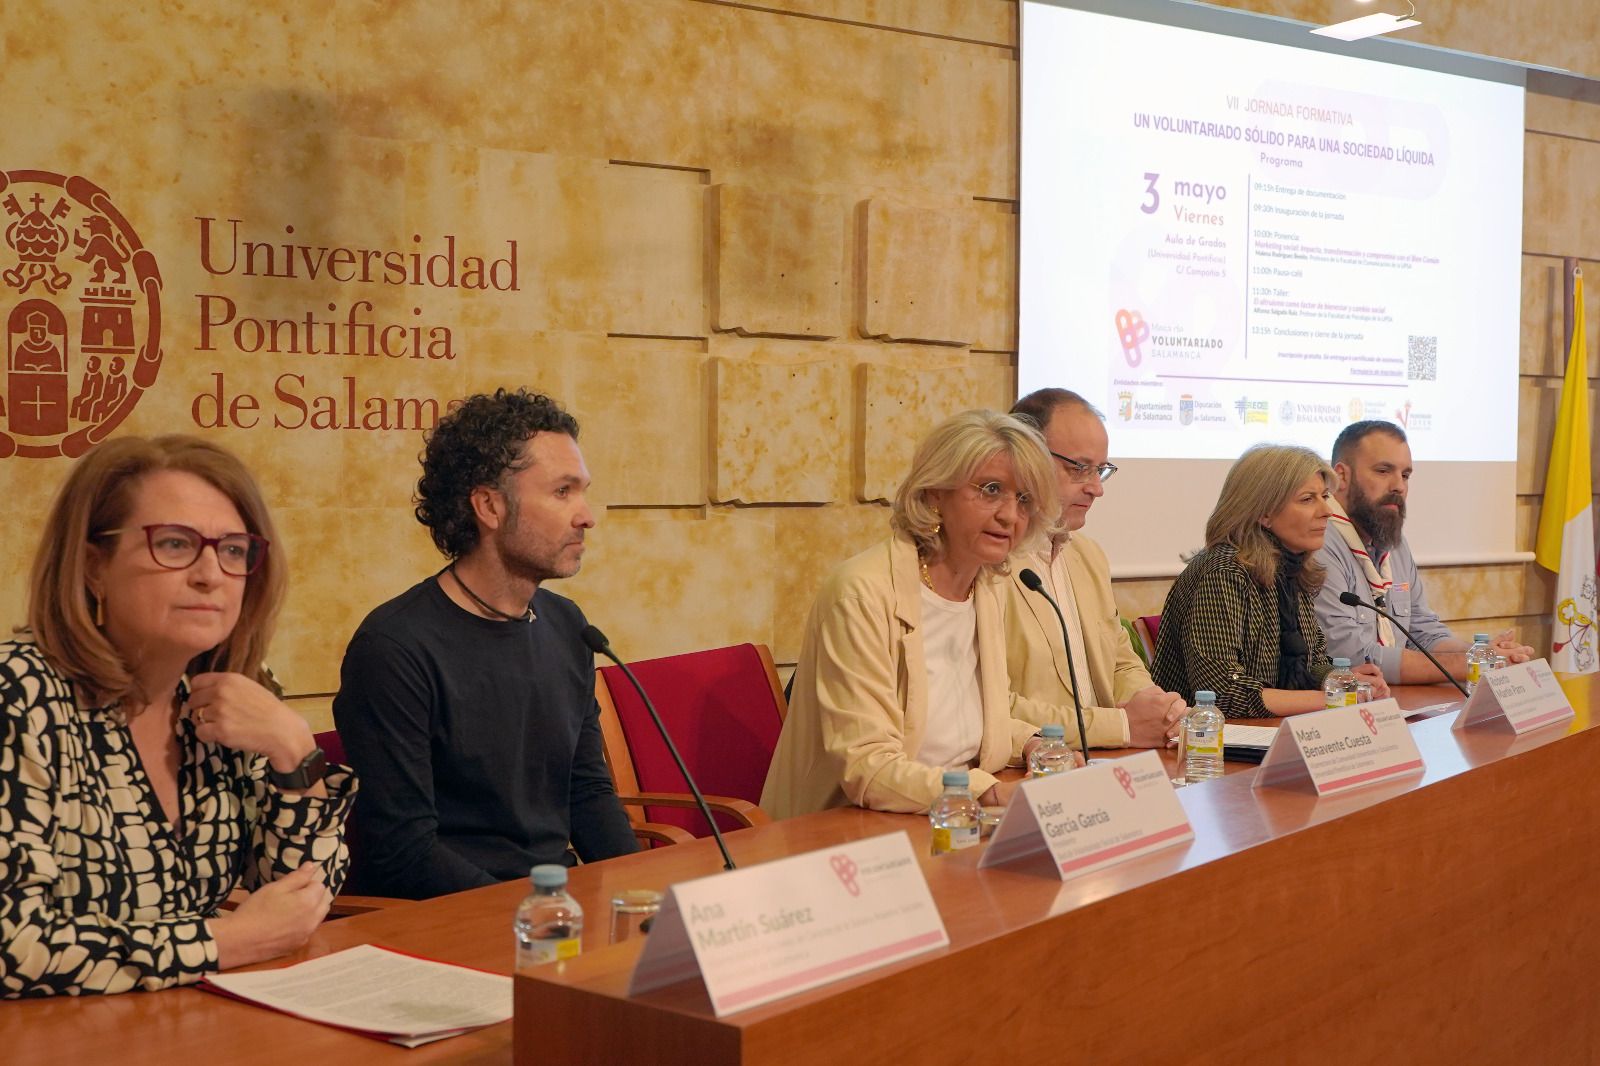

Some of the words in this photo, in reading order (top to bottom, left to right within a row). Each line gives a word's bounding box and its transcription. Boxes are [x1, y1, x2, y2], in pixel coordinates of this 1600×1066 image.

[1226, 95, 1239, 110] VII
[1244, 98, 1295, 118] JORNADA
[1296, 105, 1353, 126] FORMATIVA
[1133, 112, 1150, 129] UN
[1153, 115, 1242, 141] VOLUNTARIADO
[1244, 124, 1285, 147] SÓLIDO
[1287, 133, 1316, 151] PARA
[1319, 138, 1340, 154] UNA
[1343, 141, 1394, 161] SOCIEDAD
[1396, 146, 1435, 166] LÍQUIDA
[1260, 152, 1303, 168] Programa
[1140, 172, 1160, 214] 3
[1174, 181, 1226, 205] mayo
[1174, 204, 1224, 226] Viernes
[1165, 232, 1183, 245] Aula
[1186, 234, 1196, 245] de
[1198, 236, 1226, 248] Grados
[194, 216, 521, 292] Universidad
[193, 294, 457, 360] Pontificia
[1151, 335, 1224, 349] VOLUNTARIADO
[1151, 349, 1201, 360] SALAMANCA
[191, 372, 260, 429] de
[274, 372, 464, 431] Salam
[1134, 401, 1173, 411] Ayuntamiento
[1134, 412, 1142, 420] de
[1142, 412, 1173, 421] Salamanca
[1295, 727, 1321, 743] María
[1302, 739, 1346, 759] Benavente
[1344, 733, 1372, 750] Cuesta
[1037, 800, 1064, 819] Asier
[1046, 818, 1080, 839] García
[1079, 808, 1111, 829] García
[690, 901, 725, 925] Ana
[697, 917, 758, 951] Martín
[758, 906, 816, 936] Suárez
